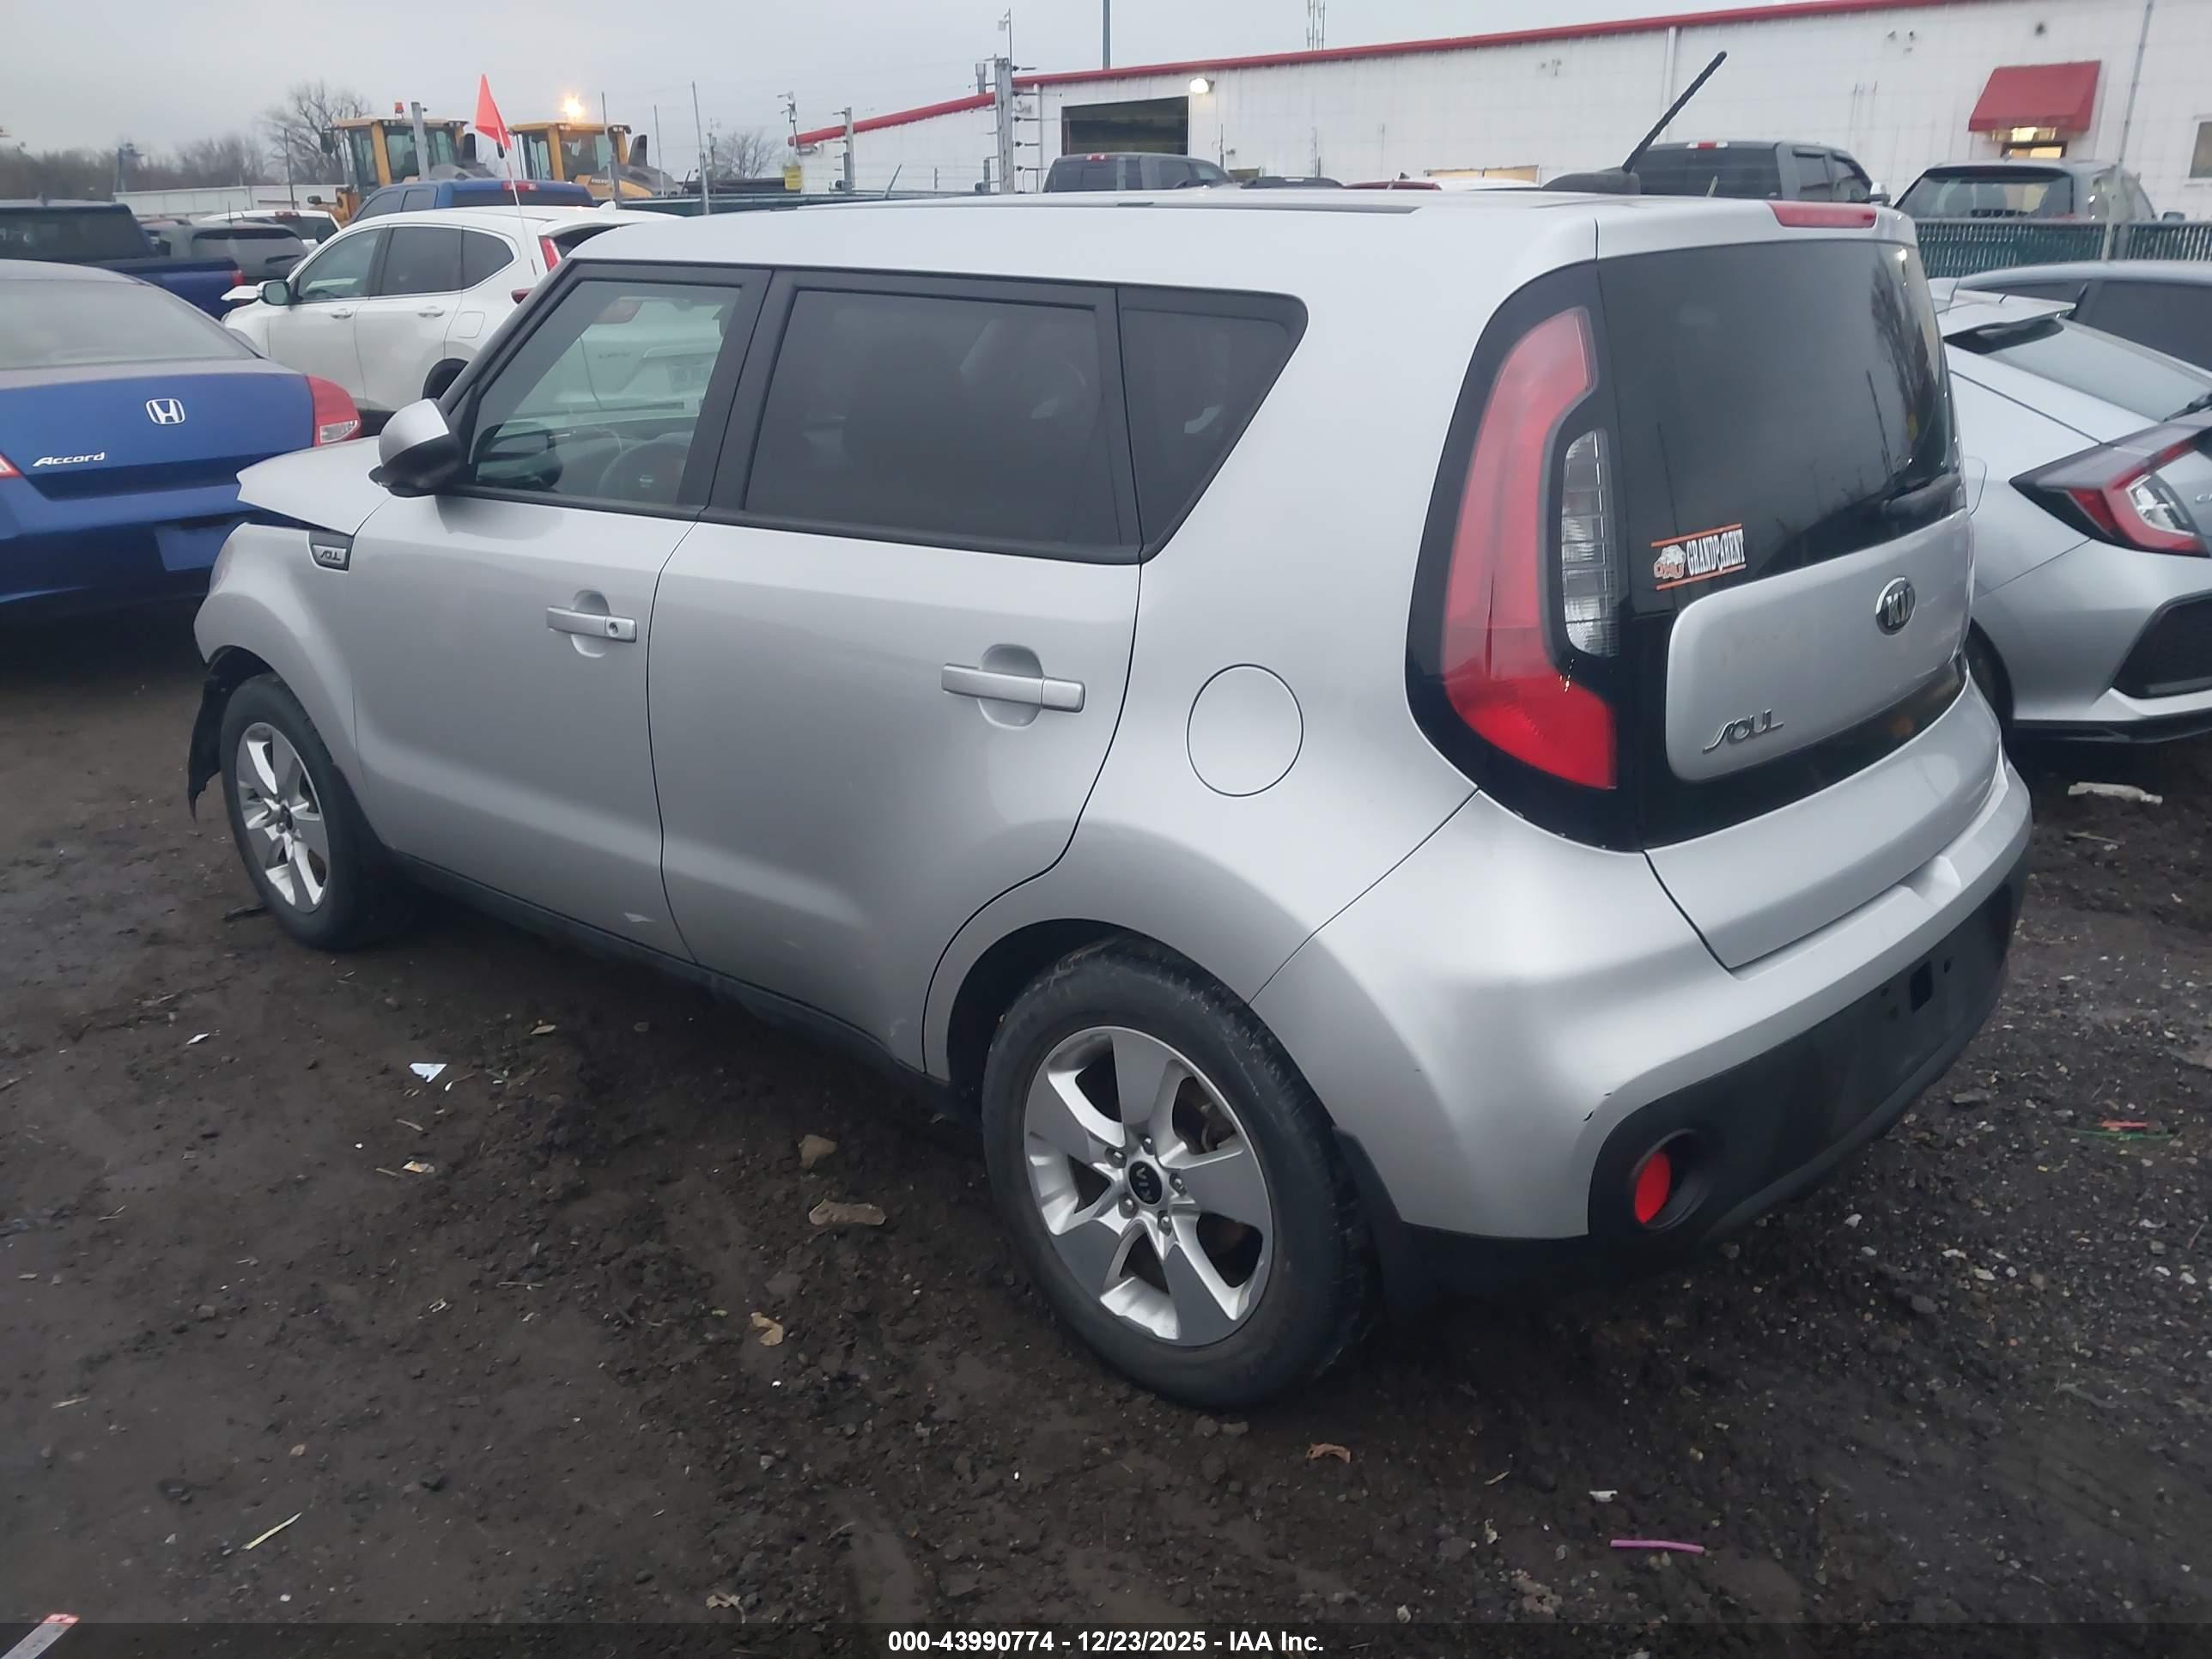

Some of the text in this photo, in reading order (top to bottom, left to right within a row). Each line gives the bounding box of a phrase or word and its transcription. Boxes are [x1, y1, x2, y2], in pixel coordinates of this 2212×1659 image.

[32, 451, 106, 467] Accord
[1686, 528, 1746, 576] GRANDPARENT
[1703, 708, 1784, 754] SOUL
